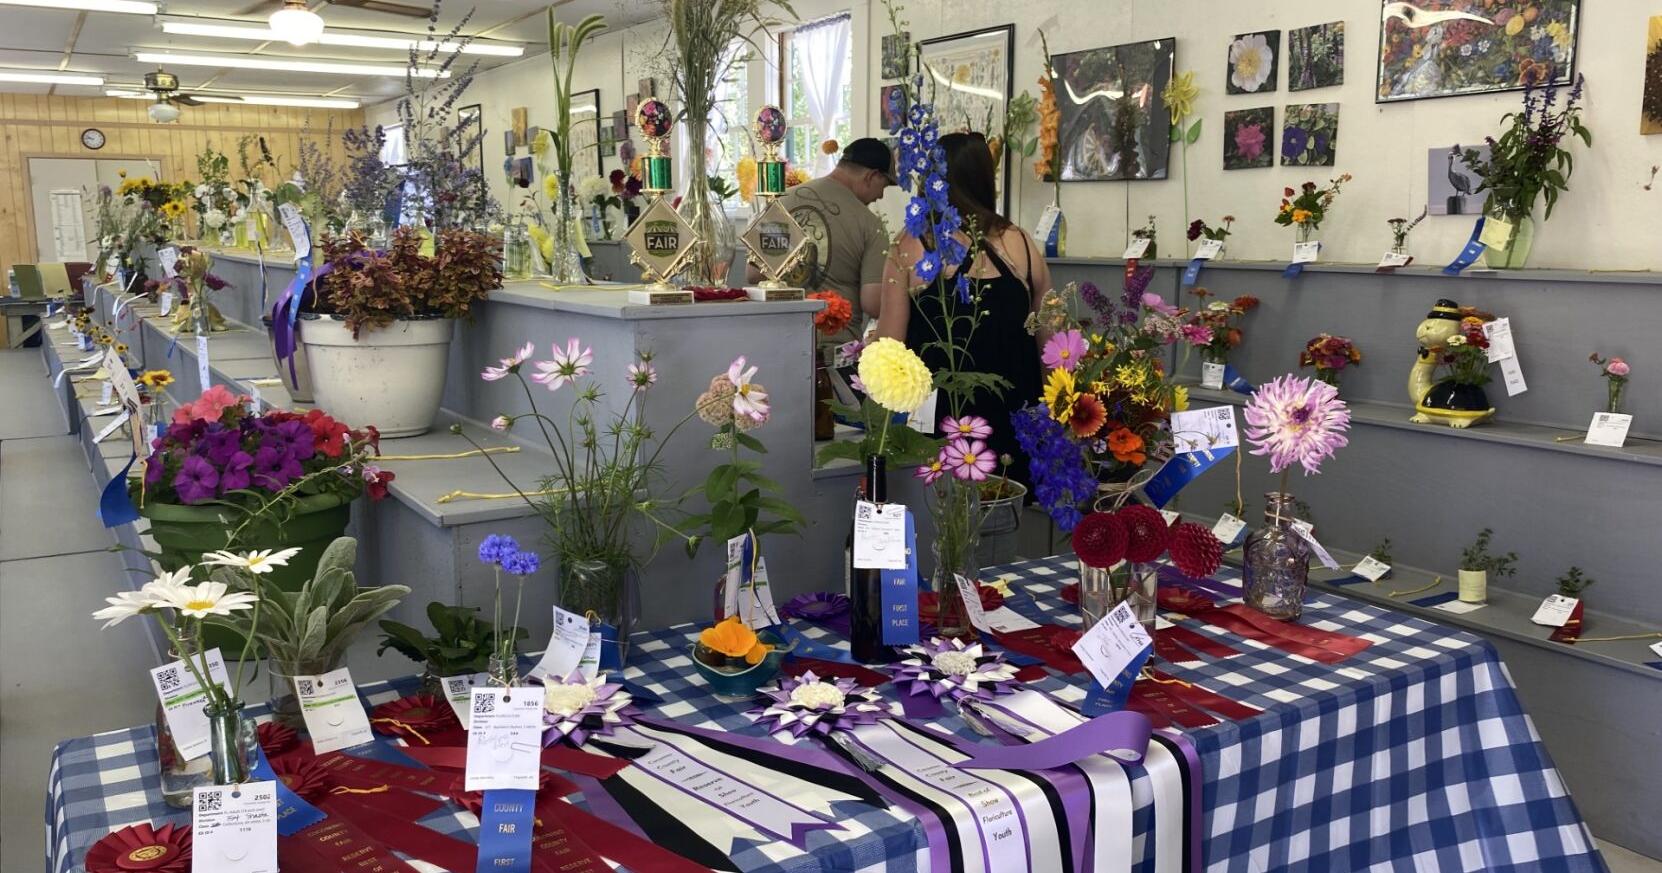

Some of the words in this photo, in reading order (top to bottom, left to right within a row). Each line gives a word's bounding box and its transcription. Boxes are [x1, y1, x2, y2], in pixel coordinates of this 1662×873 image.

[647, 237, 677, 249] FAIR
[762, 237, 788, 249] FAIR
[892, 603, 908, 612] FIRST
[892, 619, 909, 627] PLACE
[692, 777, 722, 791] Reserve
[494, 802, 524, 813] COUNTY
[981, 798, 999, 808] Show
[982, 809, 1013, 825] Floriculture
[498, 823, 516, 834] FAIR
[993, 827, 1013, 841] Youth
[493, 858, 516, 867] FIRST
